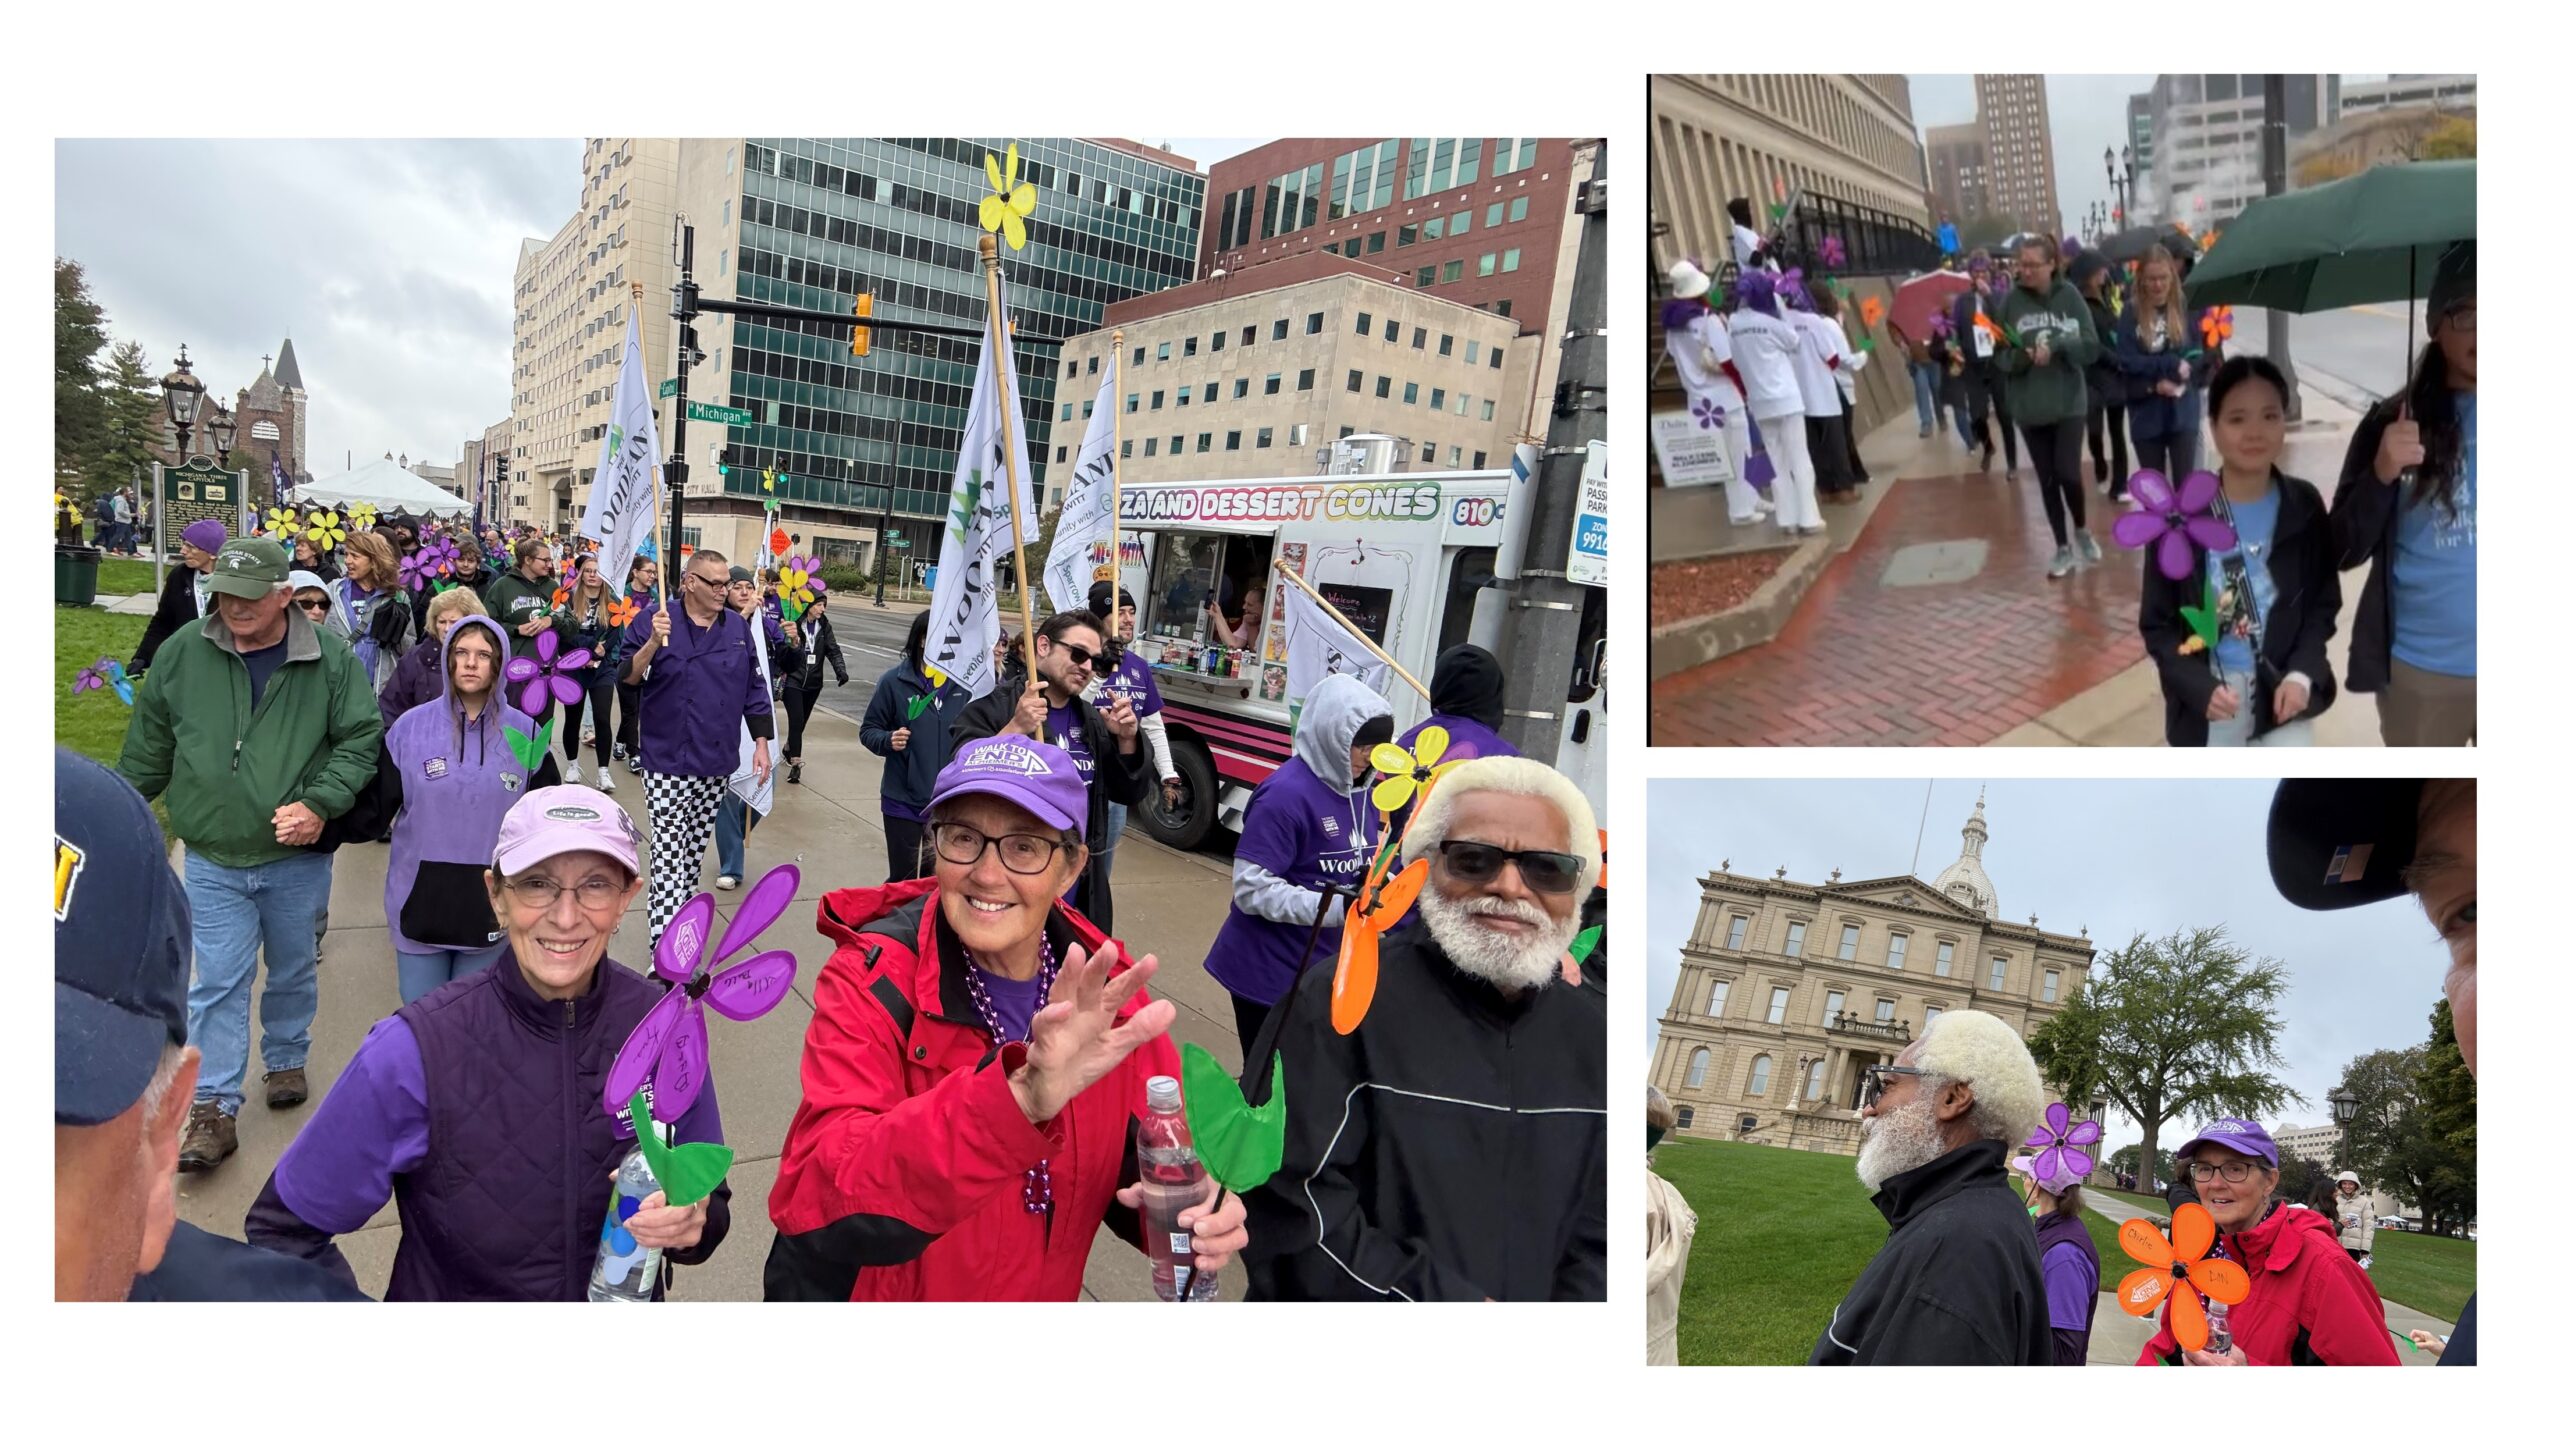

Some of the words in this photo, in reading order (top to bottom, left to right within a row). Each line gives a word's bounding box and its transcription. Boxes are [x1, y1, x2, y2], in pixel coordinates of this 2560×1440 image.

[695, 404, 741, 423] Michigan
[1597, 479, 1607, 488] WIT
[1587, 487, 1607, 501] PASS
[1062, 494, 1087, 515] WITT
[1119, 489, 1149, 519] ZA
[1150, 489, 1198, 520] AND
[1199, 485, 1325, 520] DESSERT
[1325, 482, 1441, 520] CONES
[1078, 509, 1095, 526] with
[1062, 563, 1083, 602] Sparrow
[975, 743, 1009, 754] WALK
[1010, 744, 1027, 754] TO
[968, 751, 1025, 763] END
[640, 1083, 653, 1092] ER'S
[643, 1090, 654, 1102] TS
[616, 1107, 633, 1120] WIT
